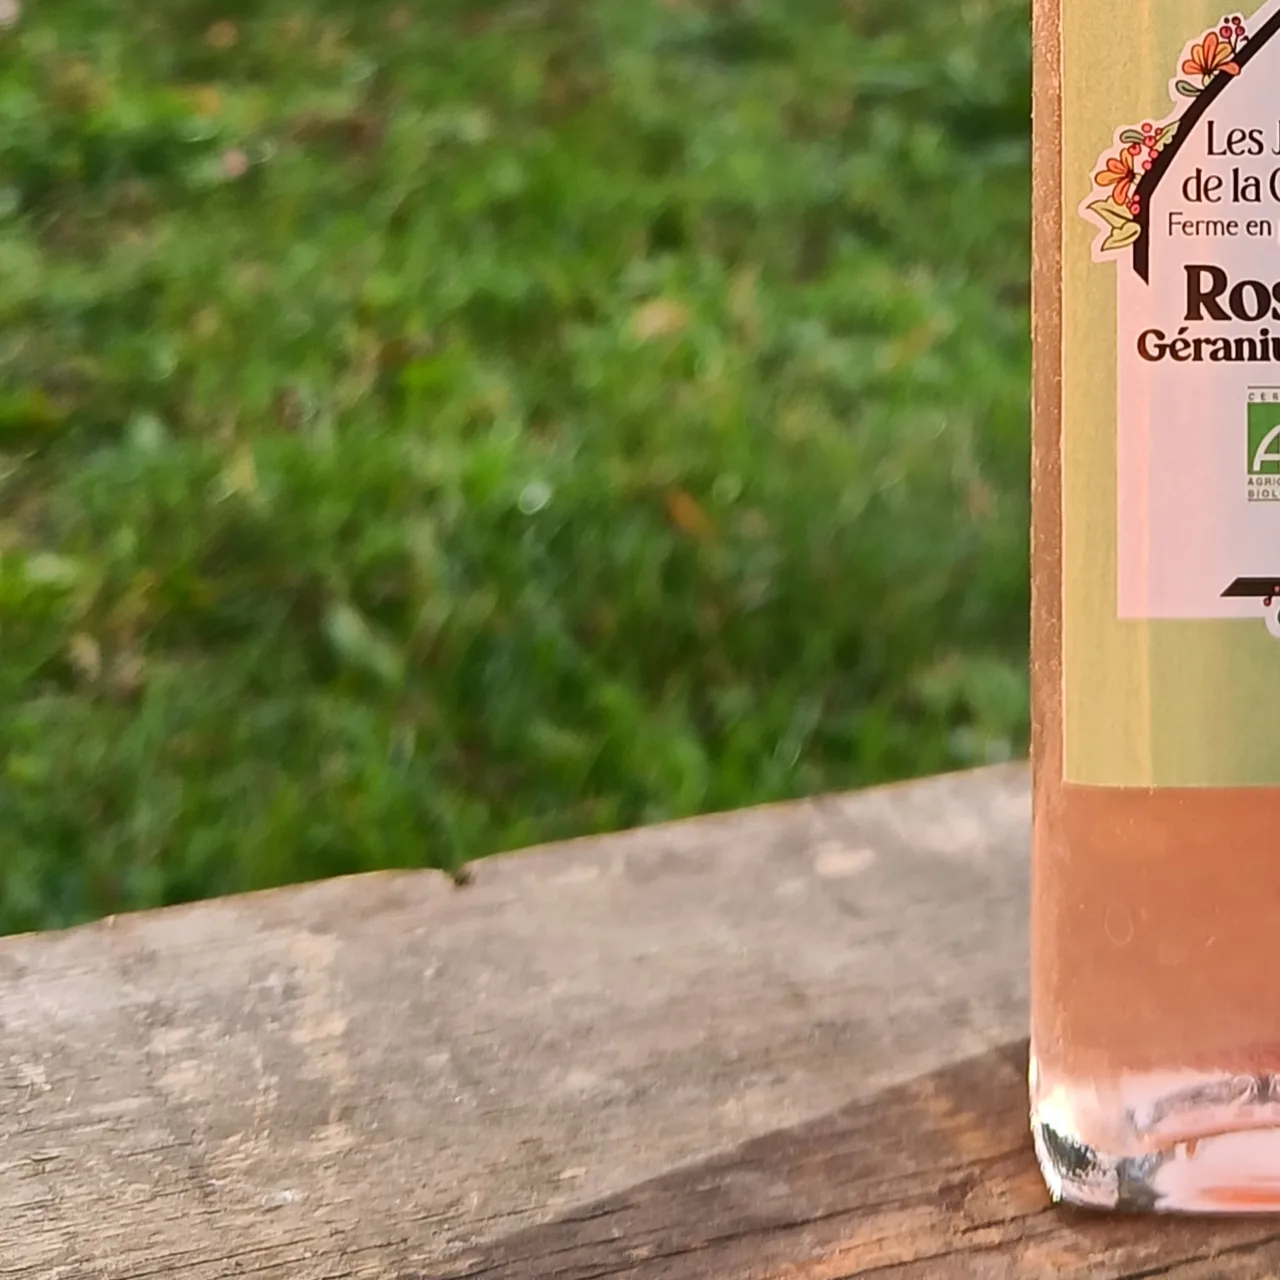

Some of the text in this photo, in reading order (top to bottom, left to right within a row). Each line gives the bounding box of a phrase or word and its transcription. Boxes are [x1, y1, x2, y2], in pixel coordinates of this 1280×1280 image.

[1206, 120, 1264, 156] Les
[1182, 168, 1223, 203] de
[1232, 167, 1262, 203] la
[1168, 212, 1239, 236] Ferme
[1246, 219, 1272, 236] en
